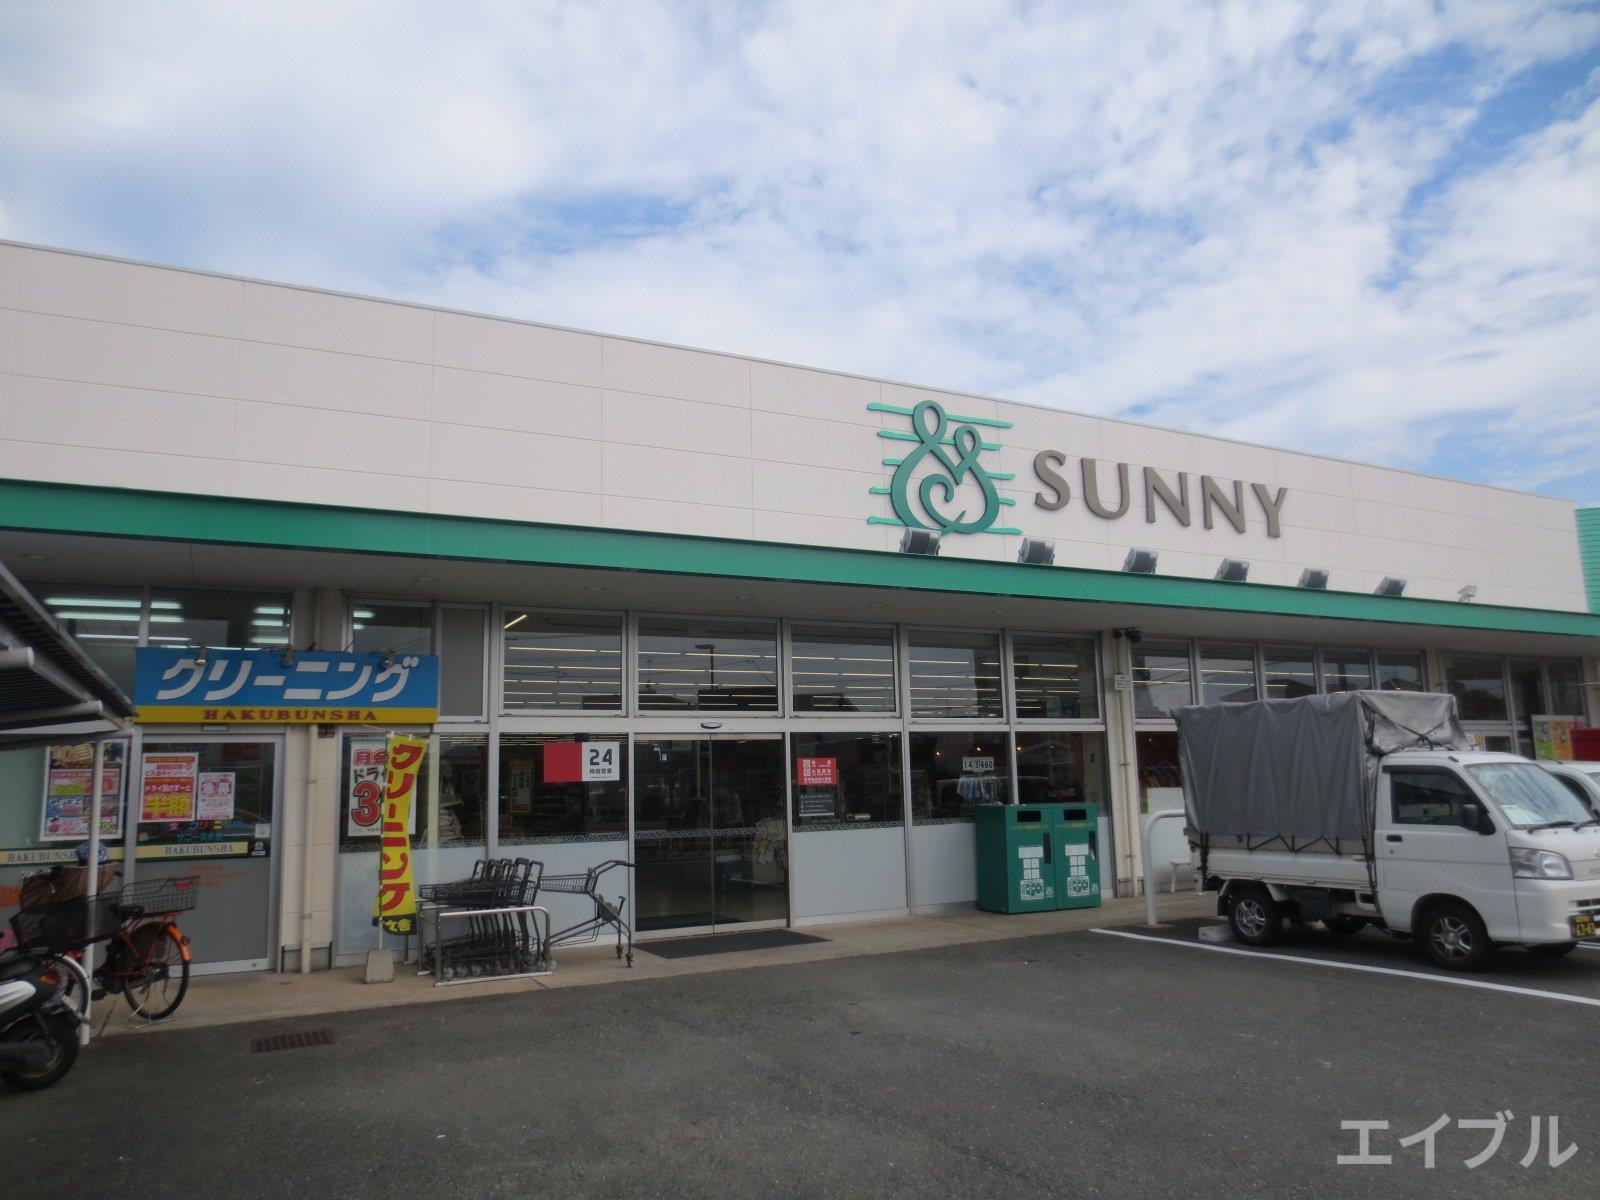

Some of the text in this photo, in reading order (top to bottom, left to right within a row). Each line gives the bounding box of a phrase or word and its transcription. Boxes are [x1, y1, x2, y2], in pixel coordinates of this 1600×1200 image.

[1034, 449, 1288, 538] SUNNY
[156, 656, 419, 702] クリーニング
[204, 709, 377, 721] HAKUBUNSHA
[589, 748, 613, 766] 24
[351, 780, 382, 827] 3
